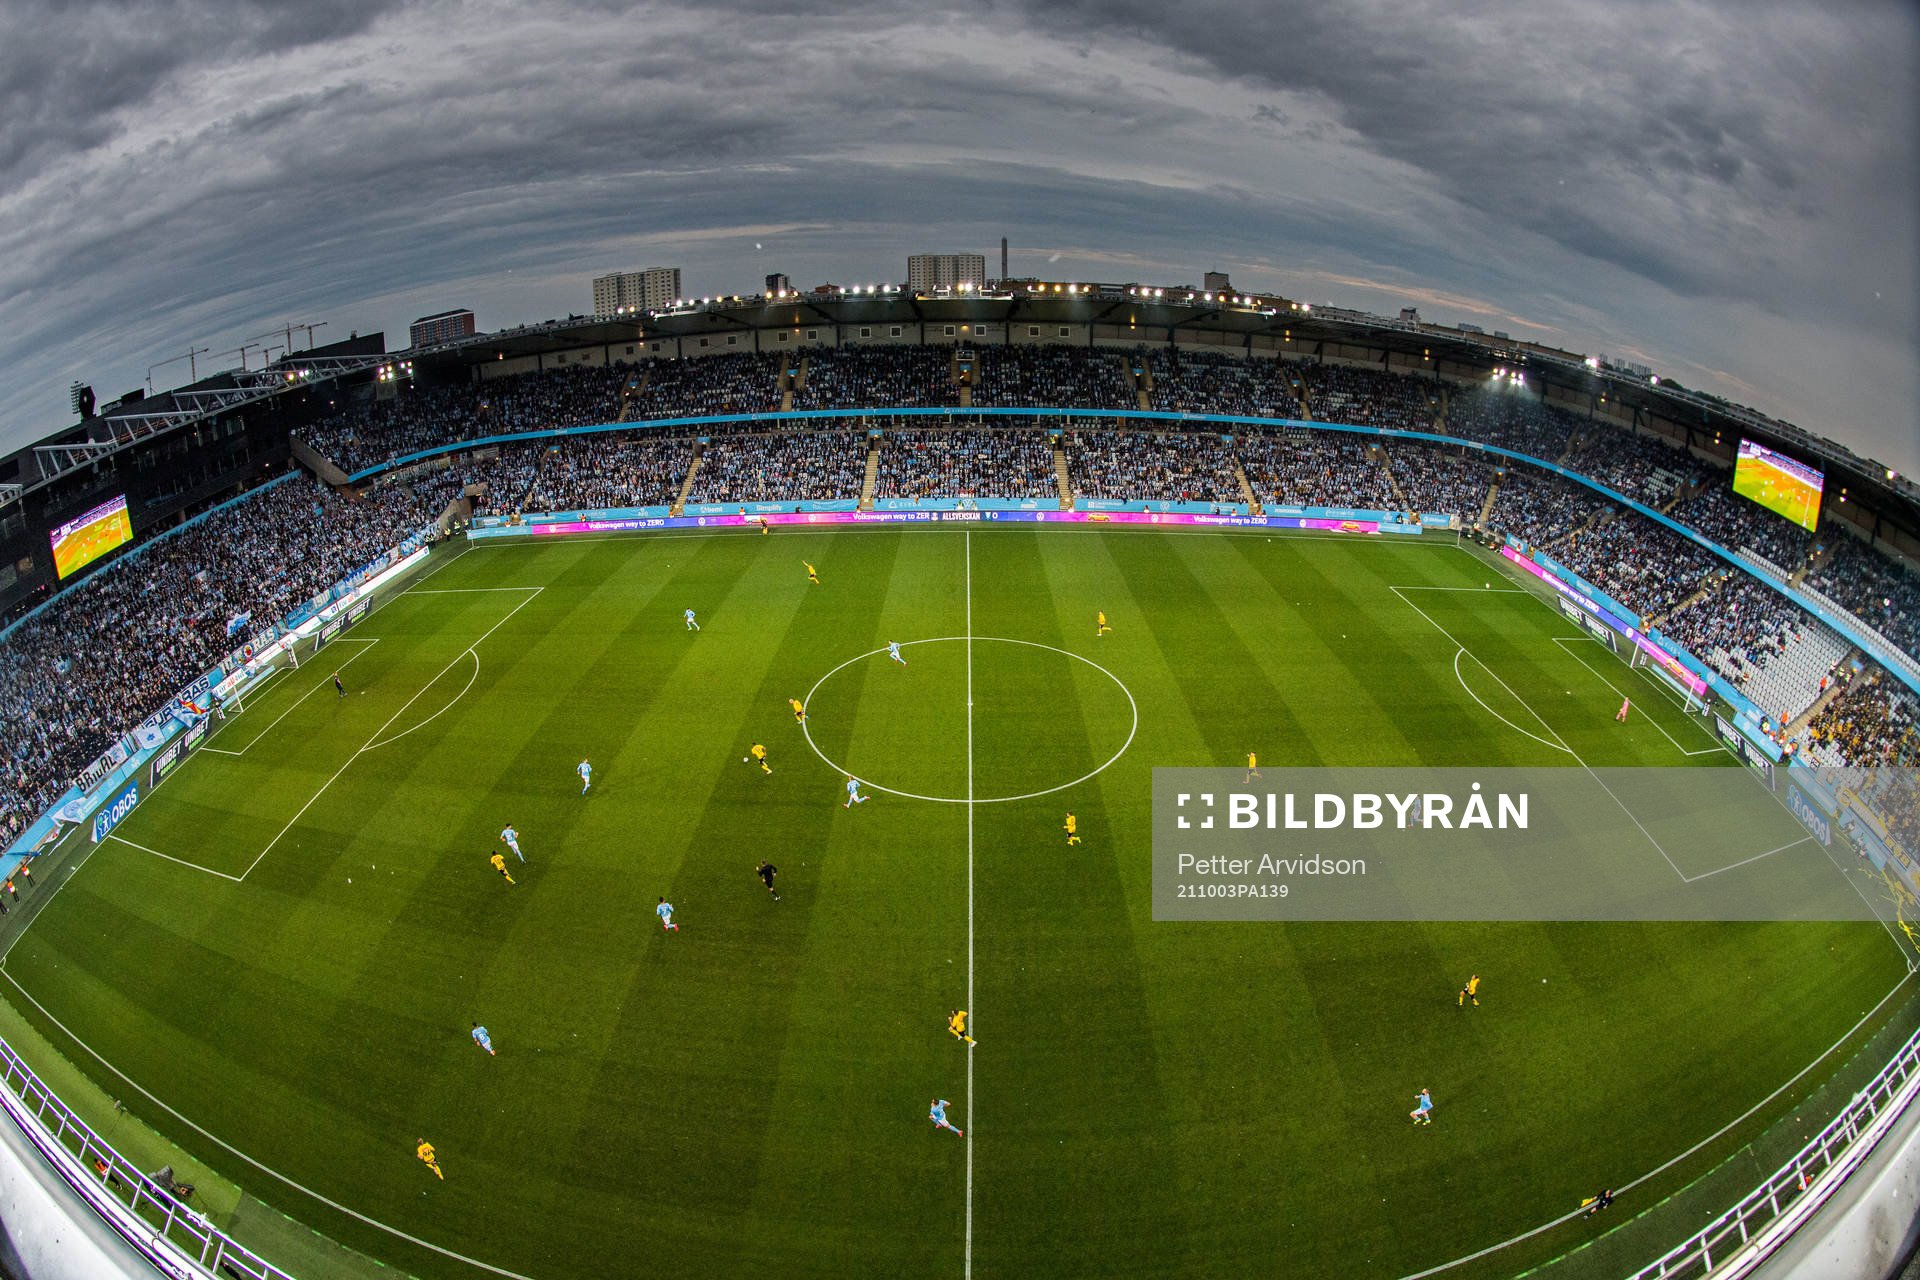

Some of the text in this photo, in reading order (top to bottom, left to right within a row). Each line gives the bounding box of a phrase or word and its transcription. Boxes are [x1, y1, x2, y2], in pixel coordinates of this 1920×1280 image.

[588, 519, 665, 530] Volkswagen way to ZERO
[852, 513, 893, 521] Volkswagen
[915, 512, 930, 520] ZER
[942, 512, 981, 520] ALLSVENSKAN
[1193, 516, 1268, 526] Volkswagen way to ZERO
[184, 715, 210, 747] UNIBET
[156, 741, 181, 773] UNIBET
[112, 788, 137, 823] OBOS
[1802, 804, 1826, 841] OBOS
